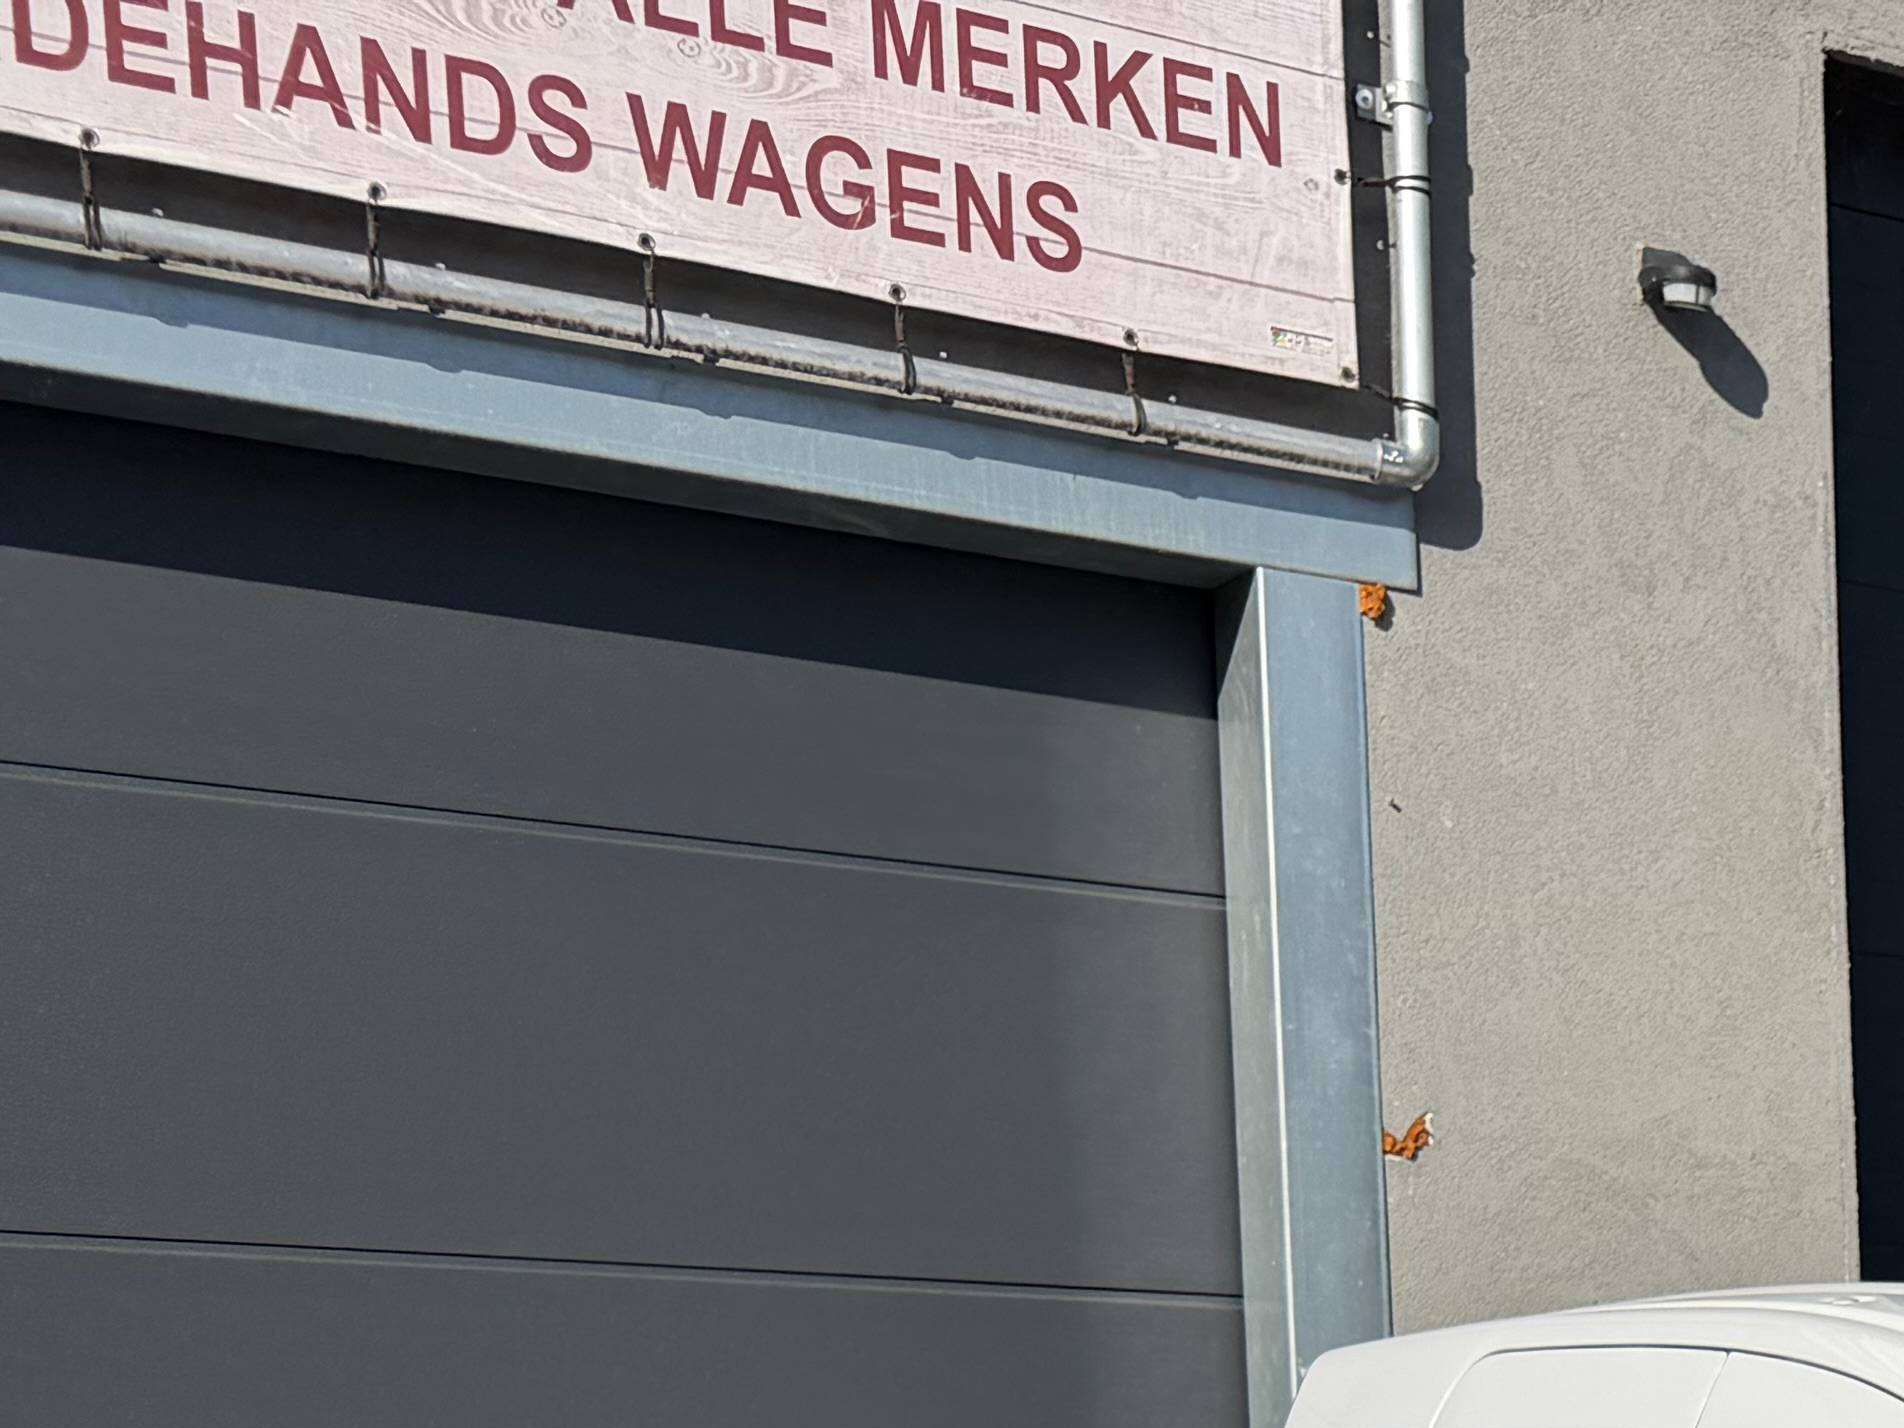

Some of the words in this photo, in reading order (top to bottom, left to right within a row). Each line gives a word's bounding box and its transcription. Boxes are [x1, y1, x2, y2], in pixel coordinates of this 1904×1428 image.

[12, 0, 593, 173] DEHANDS
[626, 92, 1083, 274] WAGENS
[871, 0, 1282, 168] MERKEN
